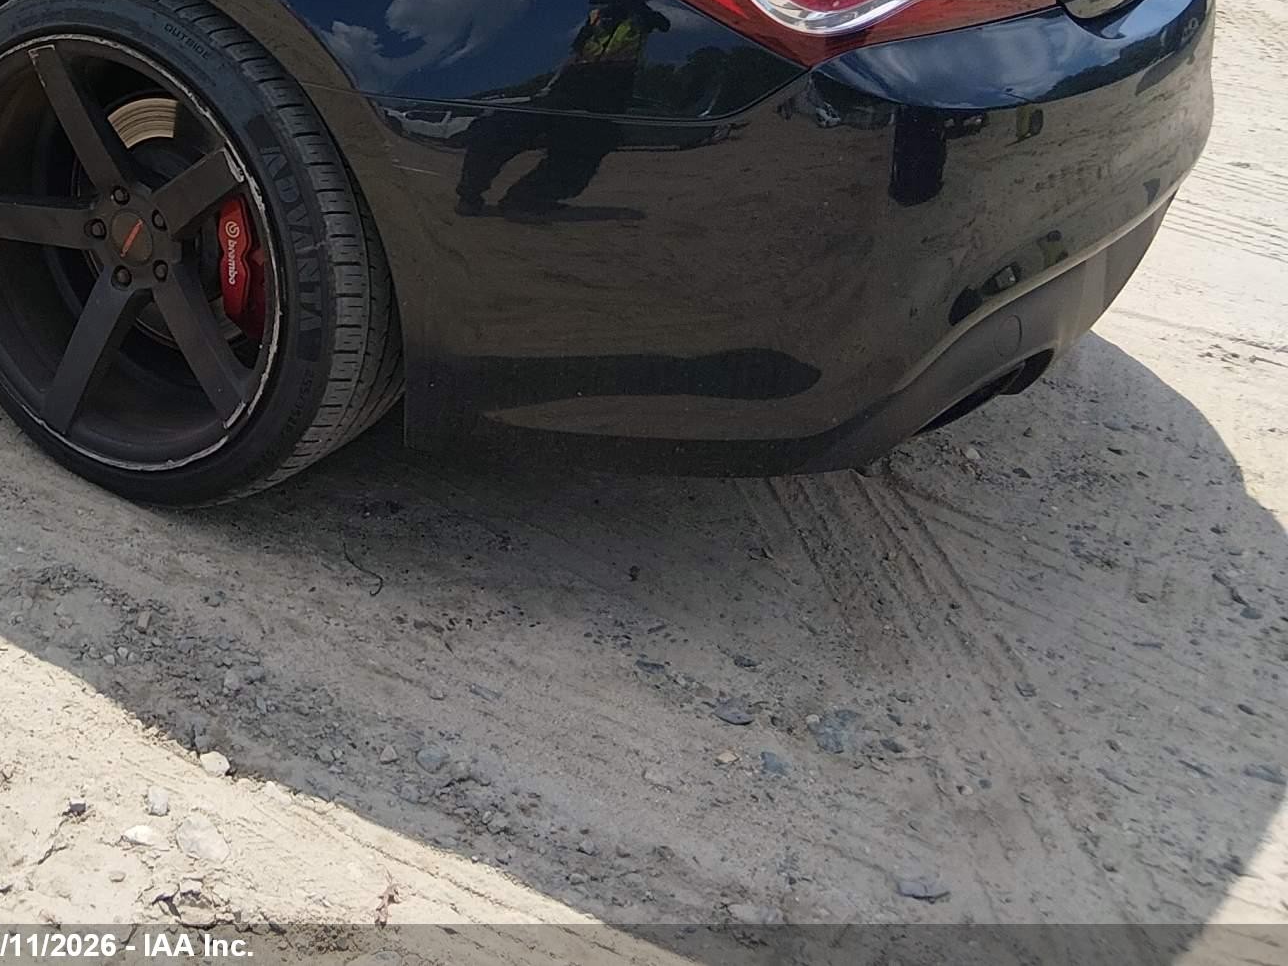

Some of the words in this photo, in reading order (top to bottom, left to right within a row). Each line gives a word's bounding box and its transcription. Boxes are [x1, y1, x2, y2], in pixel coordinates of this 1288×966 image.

[164, 23, 211, 59] OUTSIDE
[260, 146, 322, 331] ADVANTA
[227, 240, 239, 285] brembo
